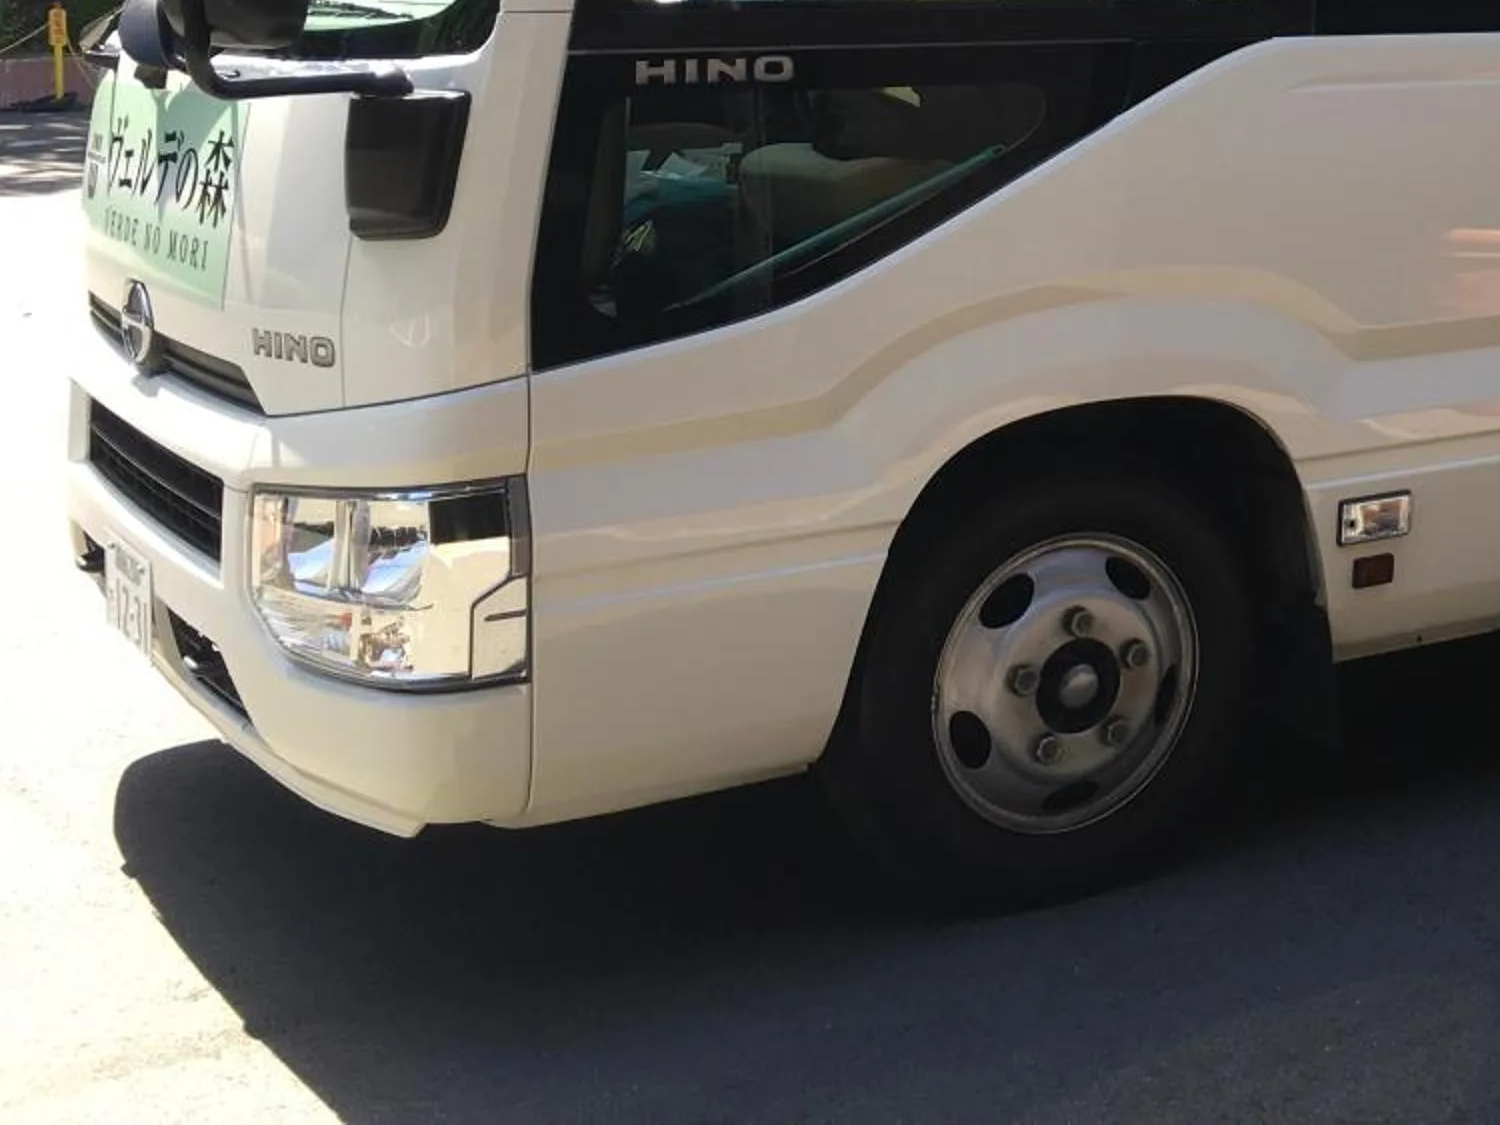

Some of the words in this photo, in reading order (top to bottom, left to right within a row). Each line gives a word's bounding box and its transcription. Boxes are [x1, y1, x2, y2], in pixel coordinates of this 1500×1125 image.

[635, 55, 794, 85] HINO
[106, 116, 235, 229] ヴェルデの森
[104, 207, 138, 247] VERDE
[143, 225, 161, 256] NO
[167, 234, 209, 272] MORI
[251, 328, 336, 368] HINO
